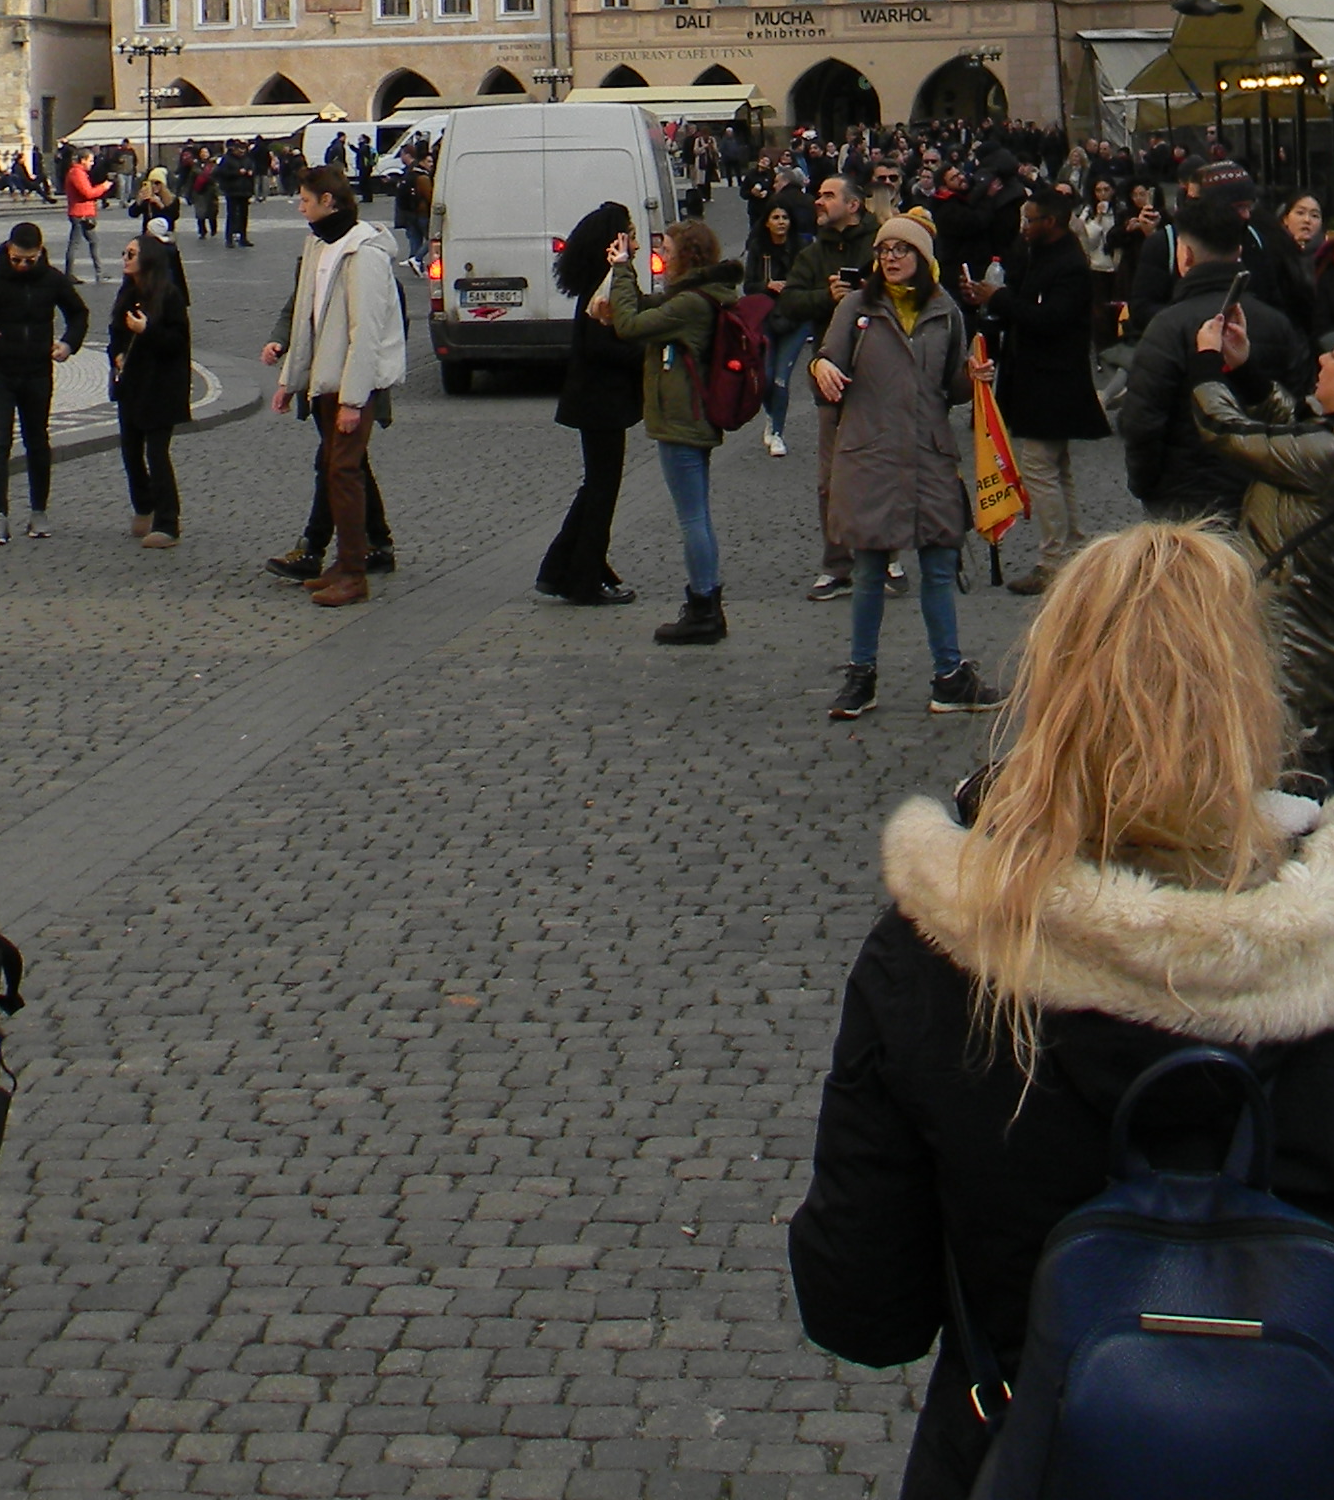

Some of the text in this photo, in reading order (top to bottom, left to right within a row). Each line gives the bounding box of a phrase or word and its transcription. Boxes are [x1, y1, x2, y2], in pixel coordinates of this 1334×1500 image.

[754, 10, 815, 26] MUCHA
[859, 7, 932, 24] WARHOL
[746, 27, 826, 40] exhibition
[595, 50, 675, 62] RESTAURANT
[710, 49, 719, 59] U
